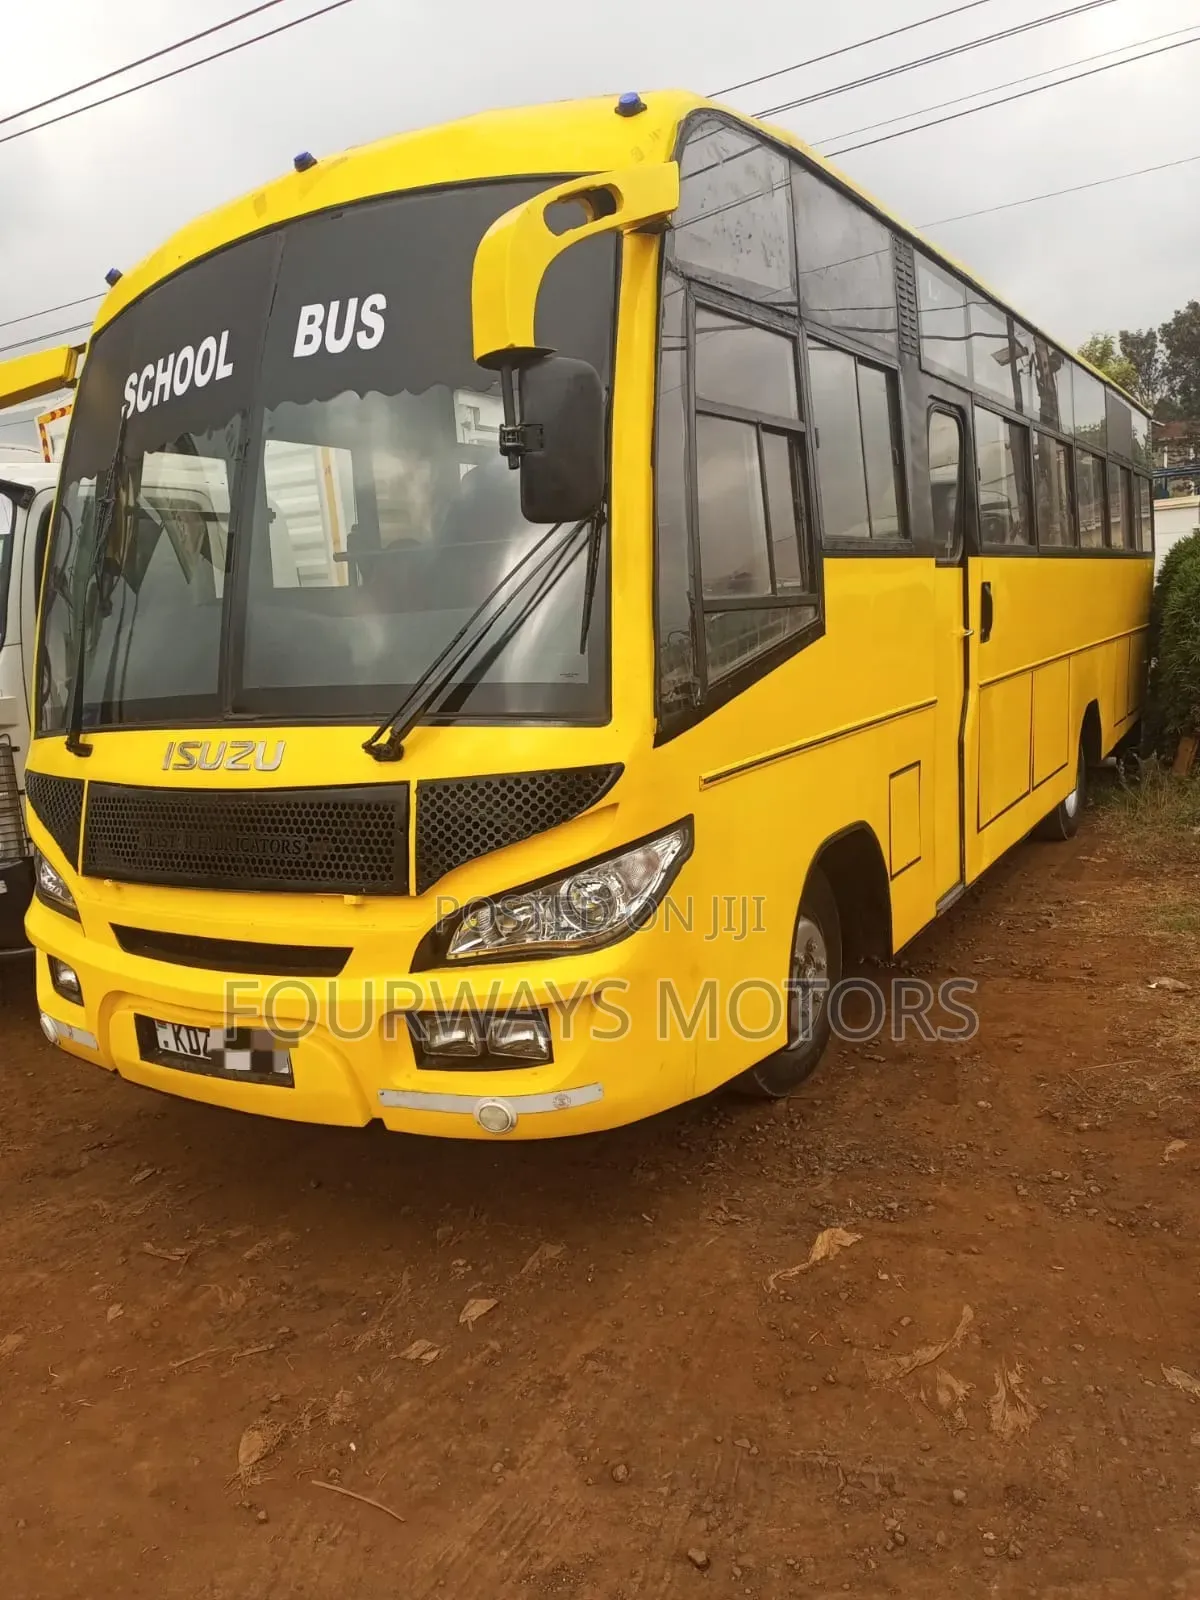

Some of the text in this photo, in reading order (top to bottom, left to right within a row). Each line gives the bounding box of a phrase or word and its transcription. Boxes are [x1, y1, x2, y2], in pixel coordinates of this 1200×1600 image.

[121, 293, 387, 420] SCHOOL BUS
[161, 740, 286, 771] ISUZU
